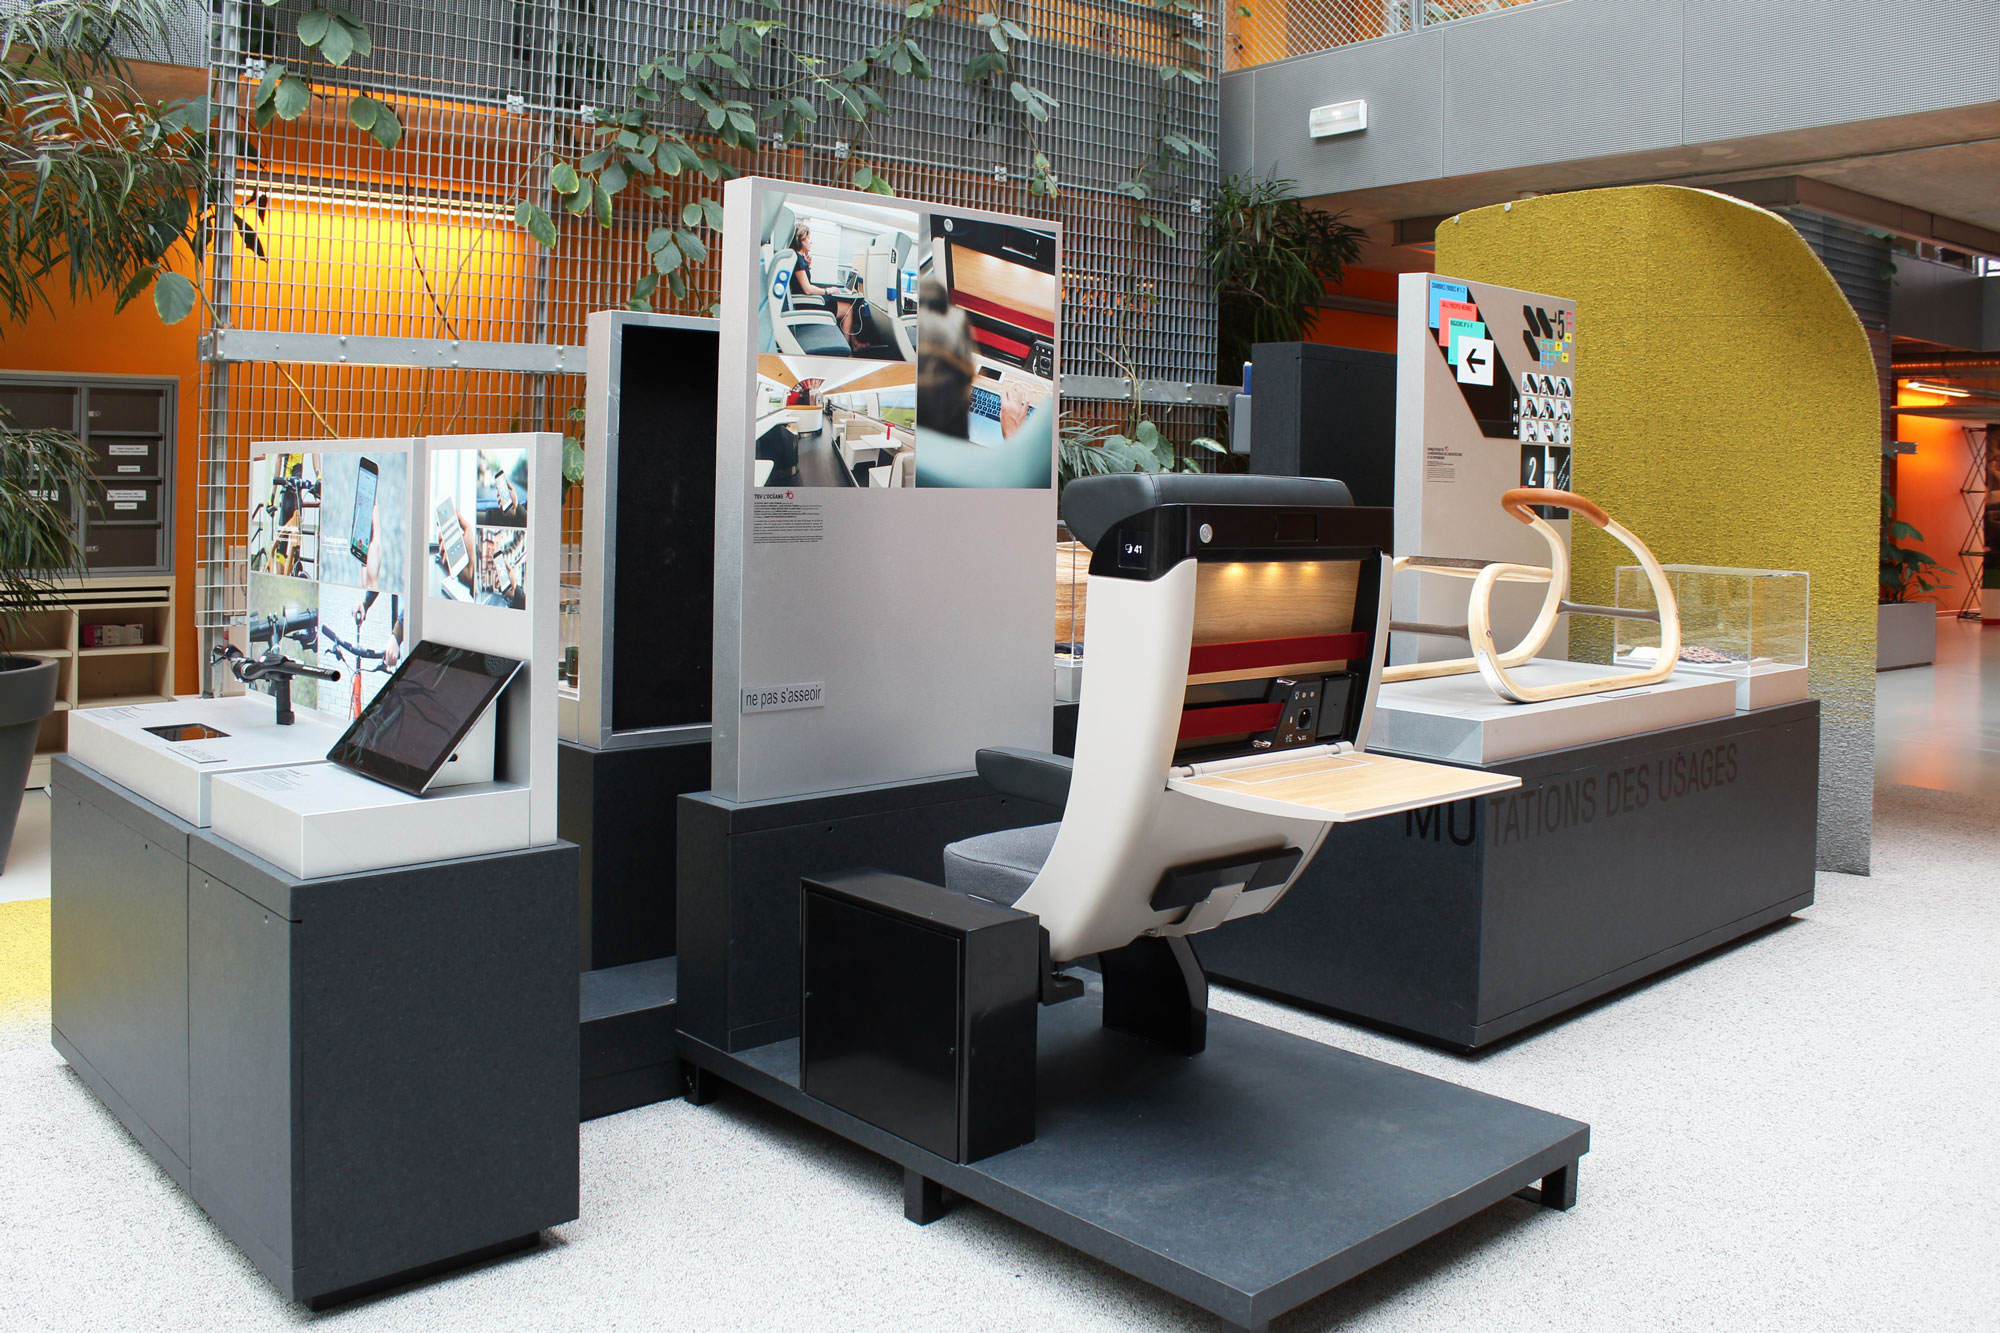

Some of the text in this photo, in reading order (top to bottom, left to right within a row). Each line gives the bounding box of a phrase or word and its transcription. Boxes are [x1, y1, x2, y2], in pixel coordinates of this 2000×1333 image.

[1528, 456, 1537, 486] 2
[1133, 544, 1142, 554] 41
[745, 684, 821, 709] ne pas s'asseoir
[1606, 763, 1650, 818] DES
[1657, 742, 1737, 802] USAGES
